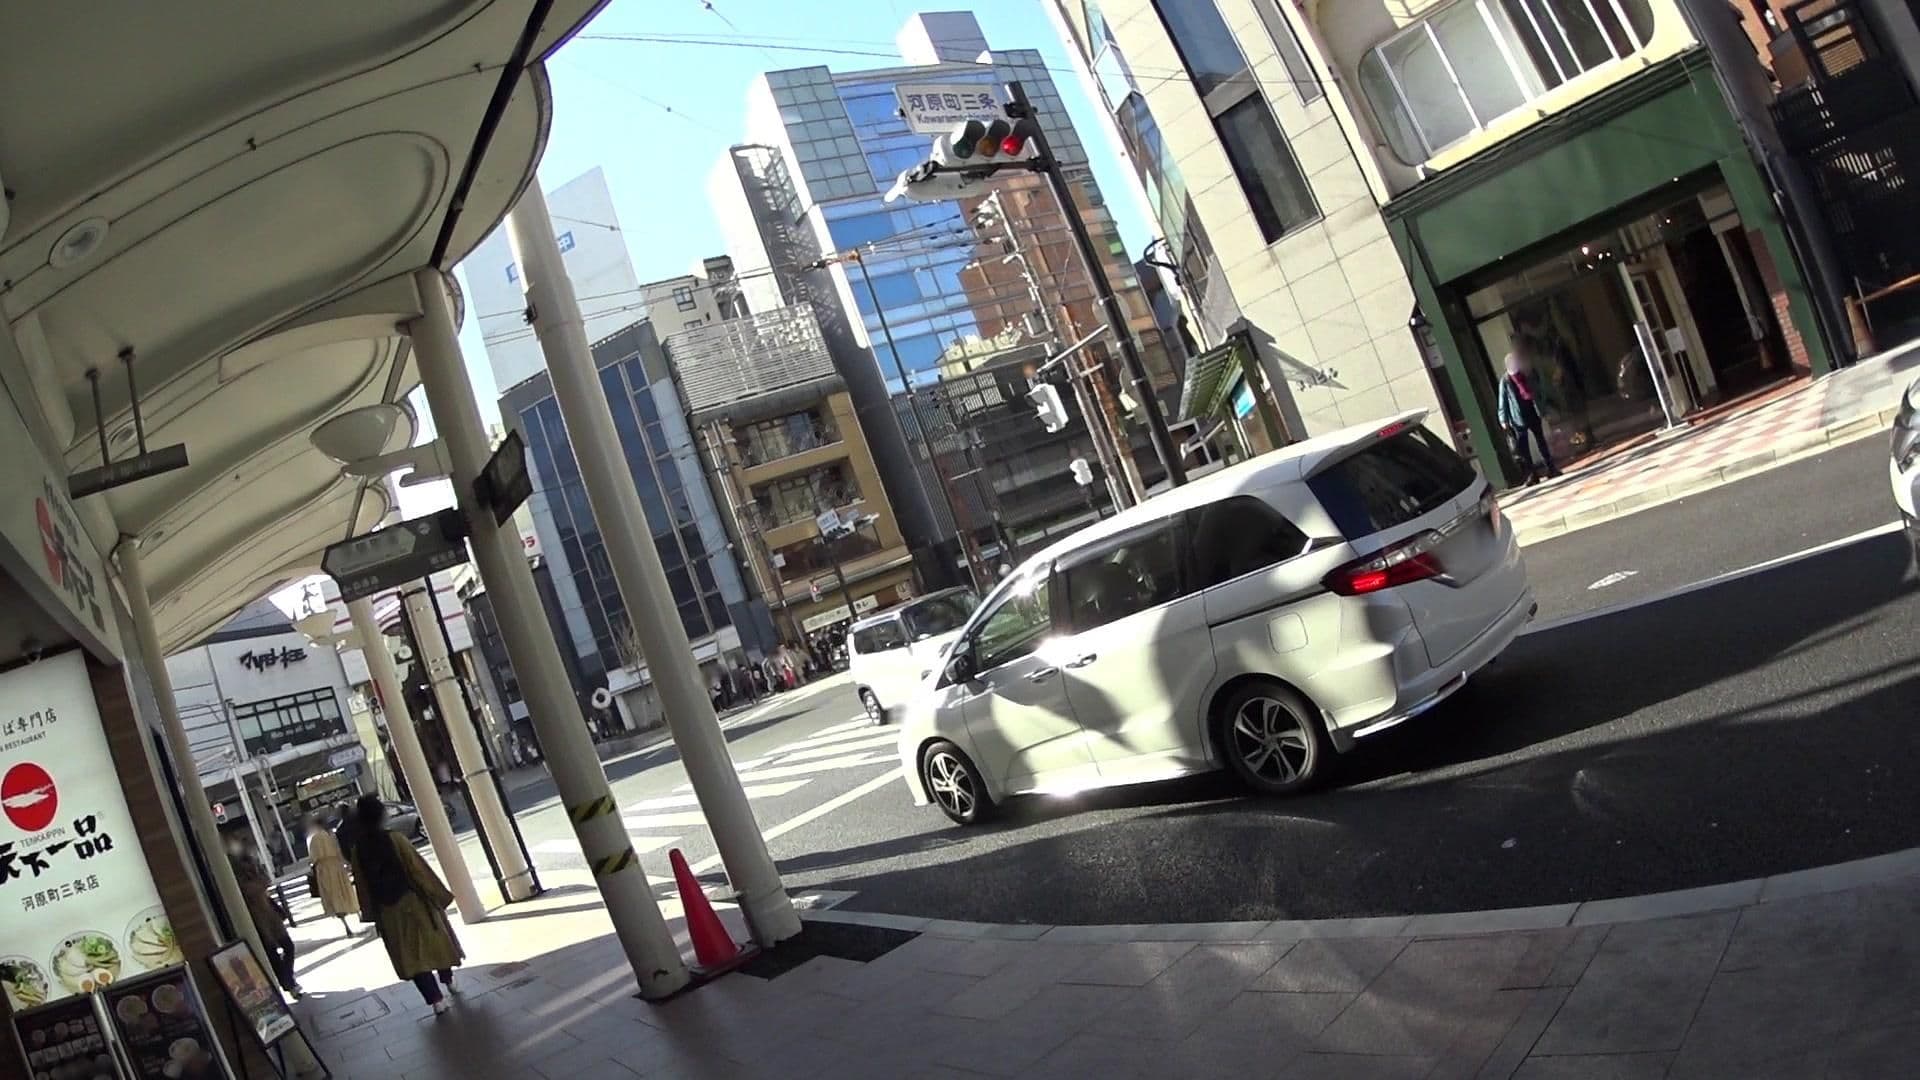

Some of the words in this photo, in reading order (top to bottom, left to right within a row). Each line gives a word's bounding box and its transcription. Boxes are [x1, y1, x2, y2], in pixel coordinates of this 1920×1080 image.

[906, 93, 998, 112] 河原町三条
[4, 731, 46, 751] RESTAURANT
[20, 826, 66, 849] TENKAIPPIN
[21, 874, 100, 912] 河原町三条店
